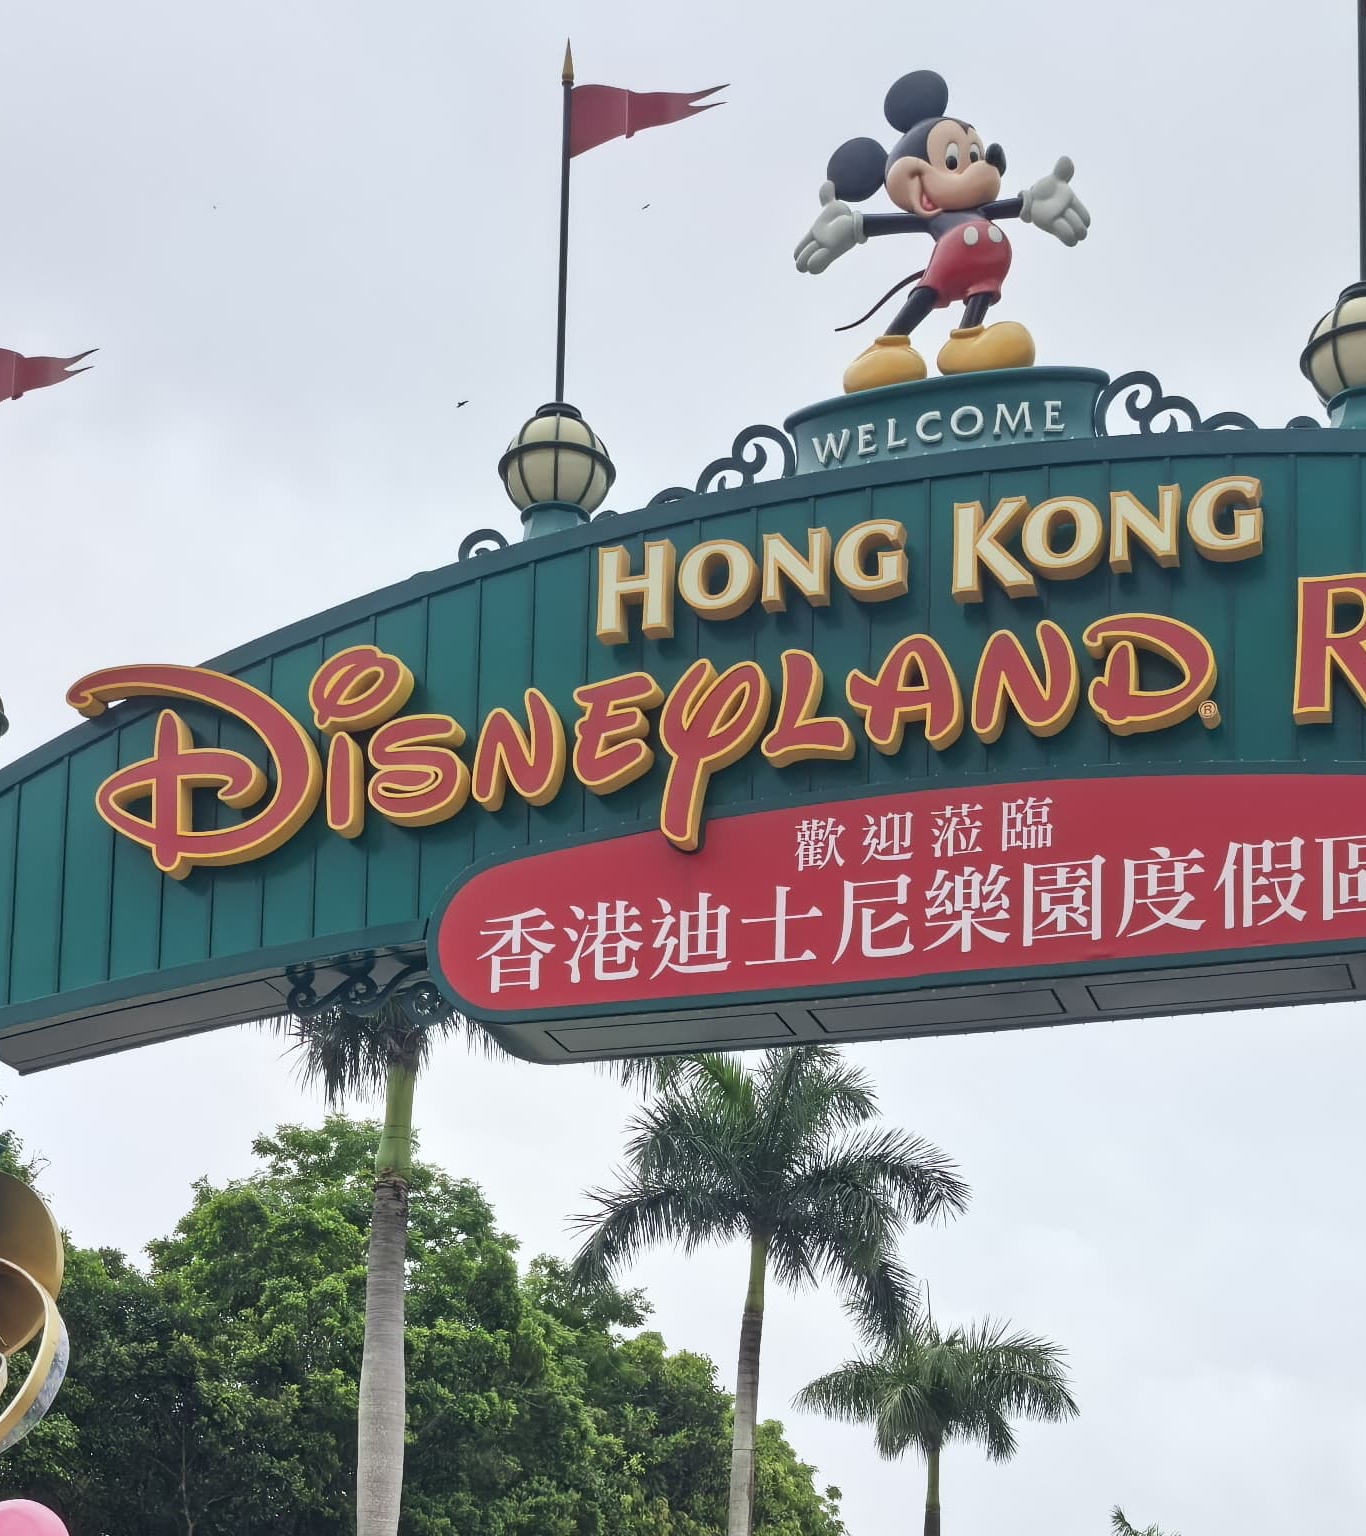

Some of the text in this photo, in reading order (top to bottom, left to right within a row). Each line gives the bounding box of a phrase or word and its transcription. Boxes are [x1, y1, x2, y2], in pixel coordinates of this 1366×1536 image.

[811, 398, 1066, 465] WELCOME
[595, 475, 1264, 645] HONG KONG
[794, 796, 1055, 873] 歡迎蒞臨
